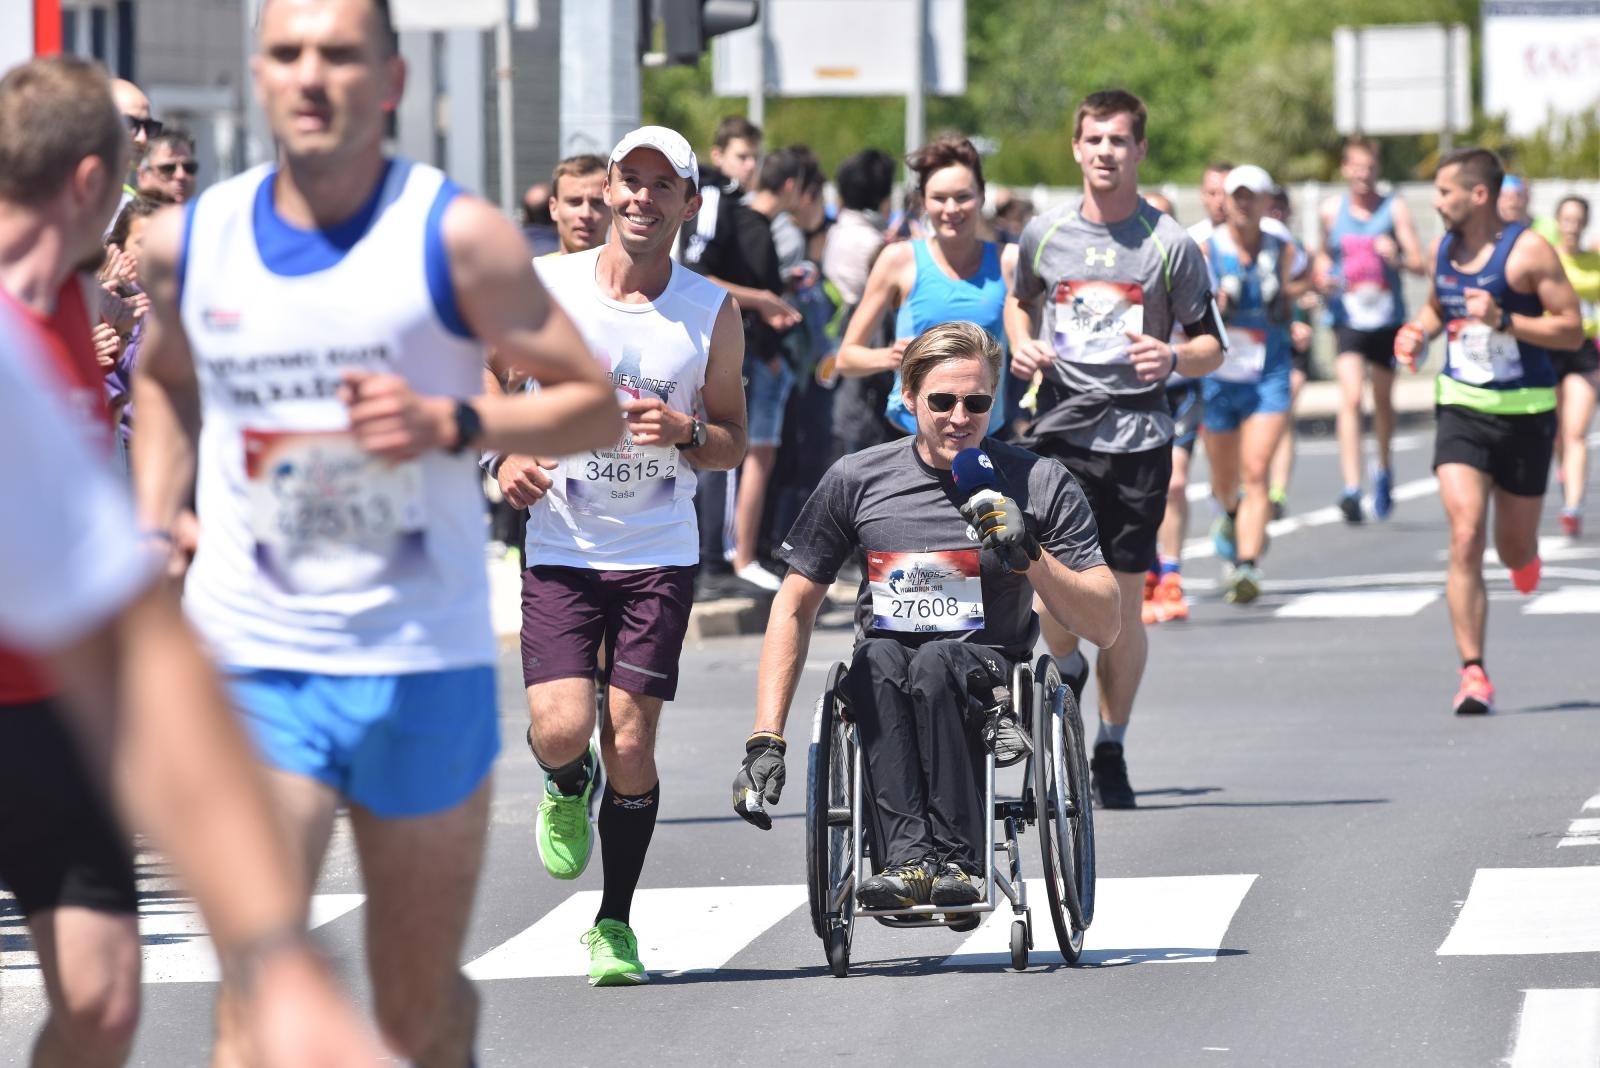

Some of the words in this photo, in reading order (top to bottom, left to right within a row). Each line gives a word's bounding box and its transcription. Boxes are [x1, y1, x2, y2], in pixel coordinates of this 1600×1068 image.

[586, 459, 659, 483] 34615
[665, 465, 675, 478] 2
[610, 490, 635, 499] Saša
[891, 597, 959, 618] 27608
[970, 603, 979, 615] 4
[914, 623, 937, 632] Aron
